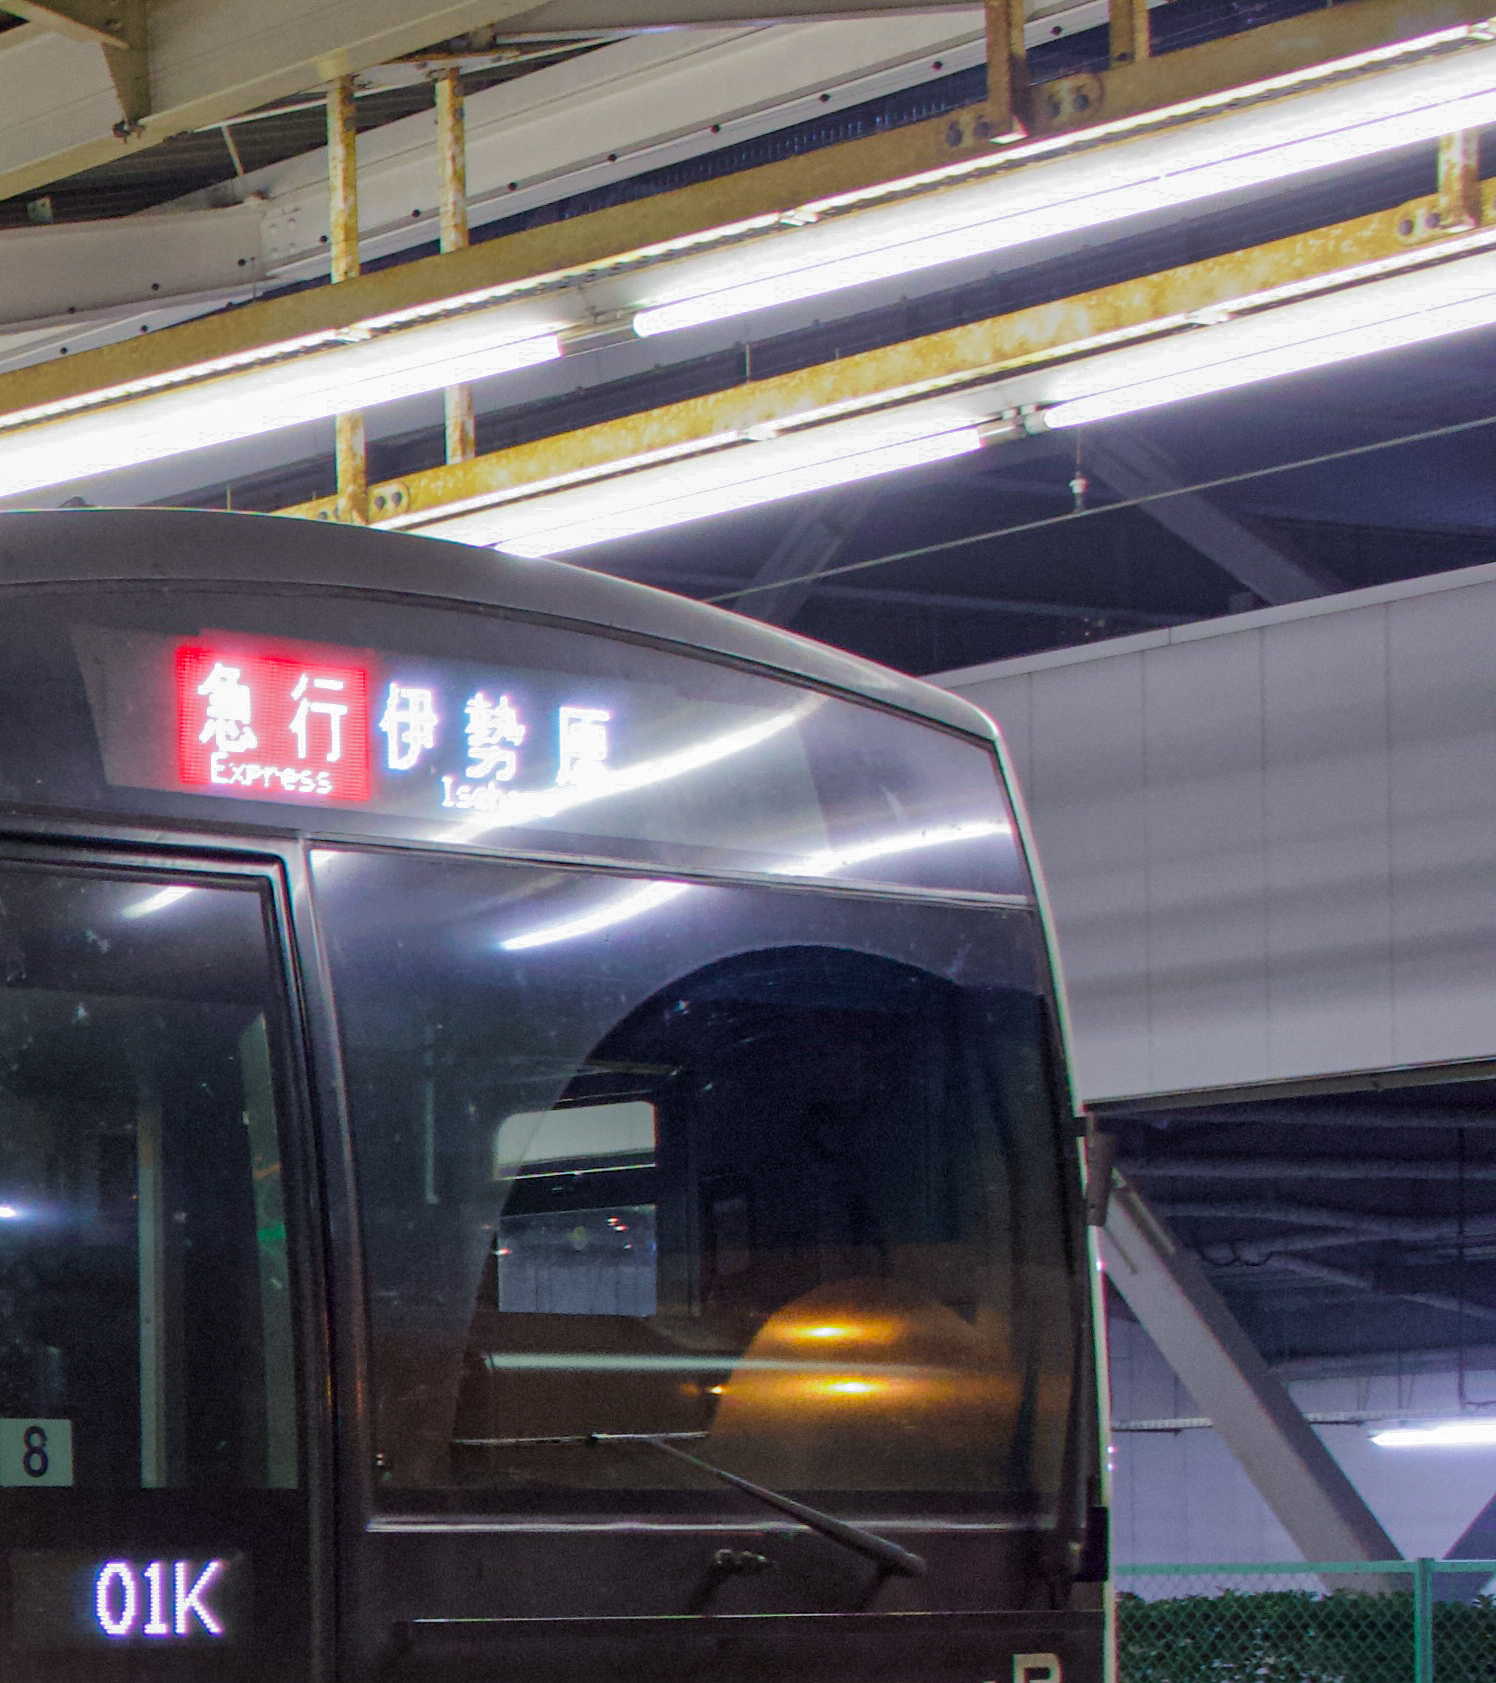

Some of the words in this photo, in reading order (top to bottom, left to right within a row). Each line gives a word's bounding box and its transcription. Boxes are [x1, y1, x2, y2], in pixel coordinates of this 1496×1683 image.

[197, 662, 348, 763] 急行
[209, 750, 333, 795] Express
[22, 1425, 49, 1478] 8
